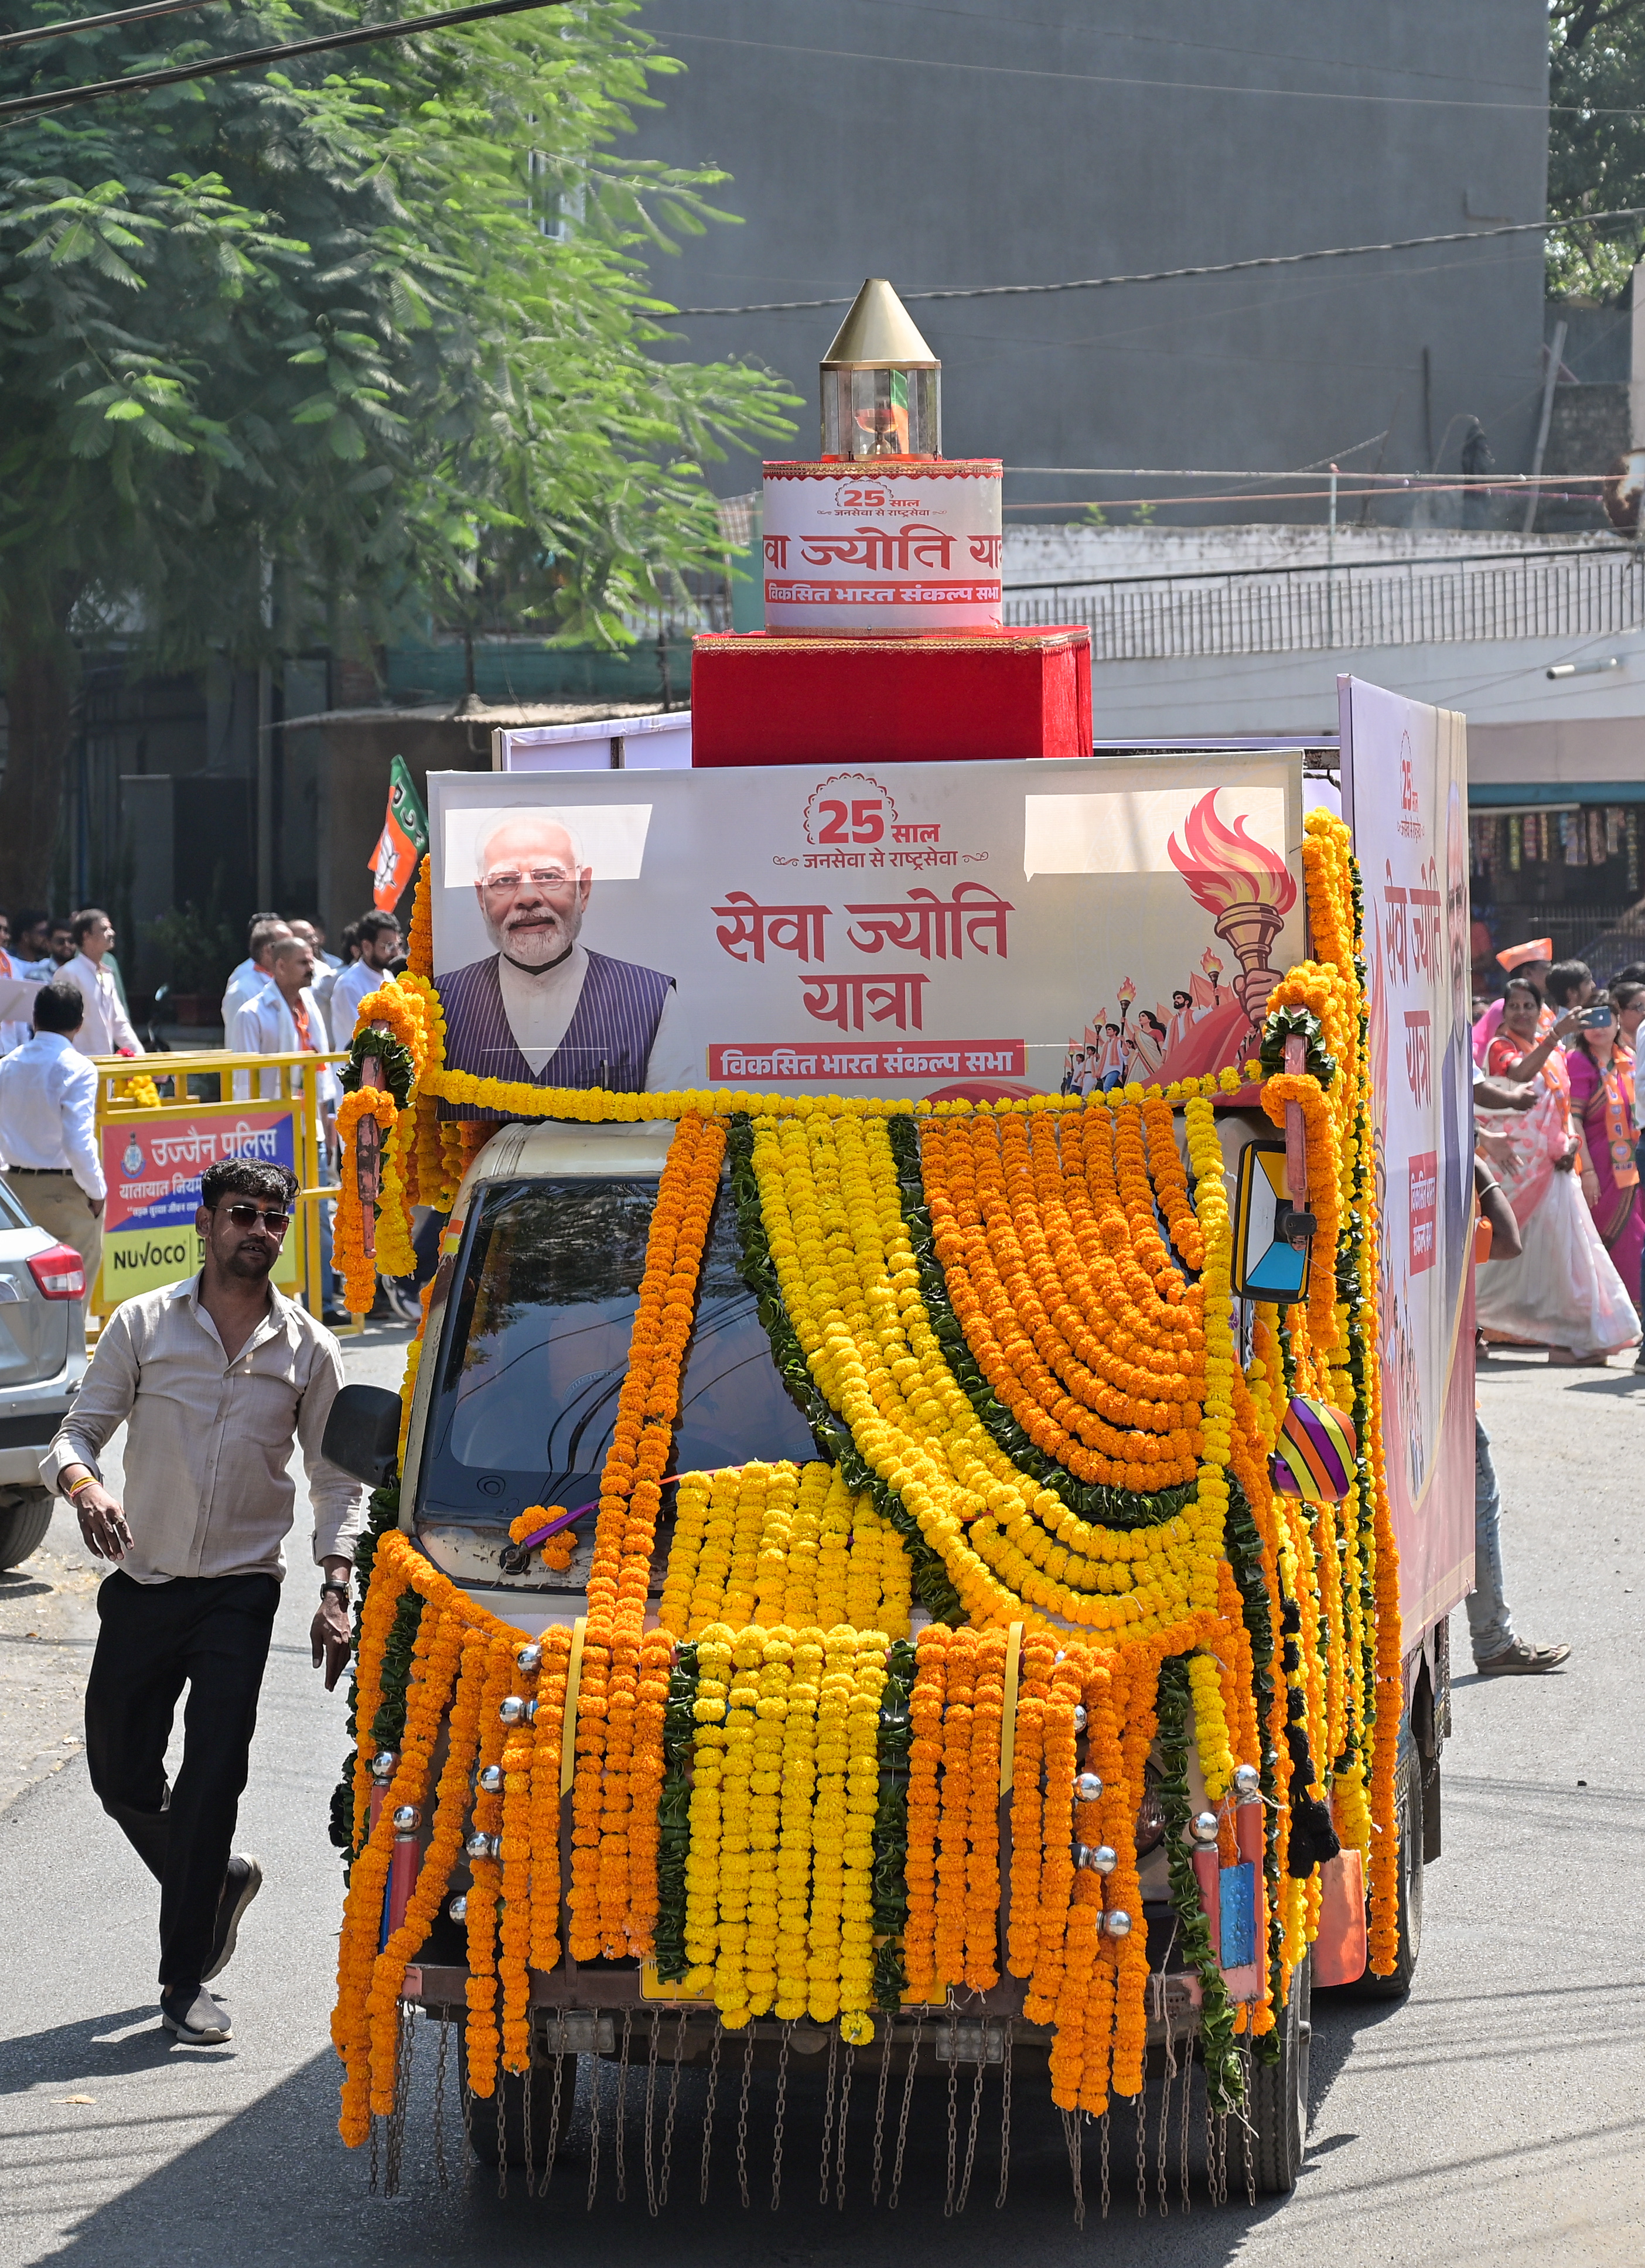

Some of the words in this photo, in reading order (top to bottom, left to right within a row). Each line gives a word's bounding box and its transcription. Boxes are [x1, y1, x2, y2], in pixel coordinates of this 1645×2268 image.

[834, 508, 872, 516] जनसेवा
[875, 508, 885, 516] से
[887, 508, 930, 518] राष्ट्रसेवा
[844, 489, 885, 507] 25
[889, 498, 920, 507] साल
[763, 534, 791, 570] वा
[798, 523, 958, 571] ज्योति
[966, 534, 1002, 570] या
[768, 582, 832, 602] विकसित
[835, 588, 896, 602] भारत
[900, 583, 973, 602] संकल्प
[975, 586, 999, 600] सभा
[1401, 759, 1412, 811] 25
[818, 800, 885, 844] 25
[890, 824, 941, 843] साल
[803, 848, 866, 869] जनसेवा
[869, 847, 886, 867] से
[889, 846, 959, 871] राष्ट्रसेवा
[710, 890, 834, 964] सेवा
[843, 881, 1016, 961] ज्योति
[1384, 858, 1409, 988] सेवा
[1408, 856, 1443, 988] ज्योति
[797, 972, 932, 1033] यात्रा
[720, 1049, 818, 1075] विकसित
[821, 1053, 879, 1074] भारत
[882, 1047, 960, 1073] संकल्प
[964, 1051, 1013, 1072] सभा
[1404, 1010, 1432, 1109] यात्रा
[151, 1125, 217, 1167] उज्जैन
[120, 1180, 170, 1200] यातायात
[114, 1240, 185, 1270] NUVOCO
